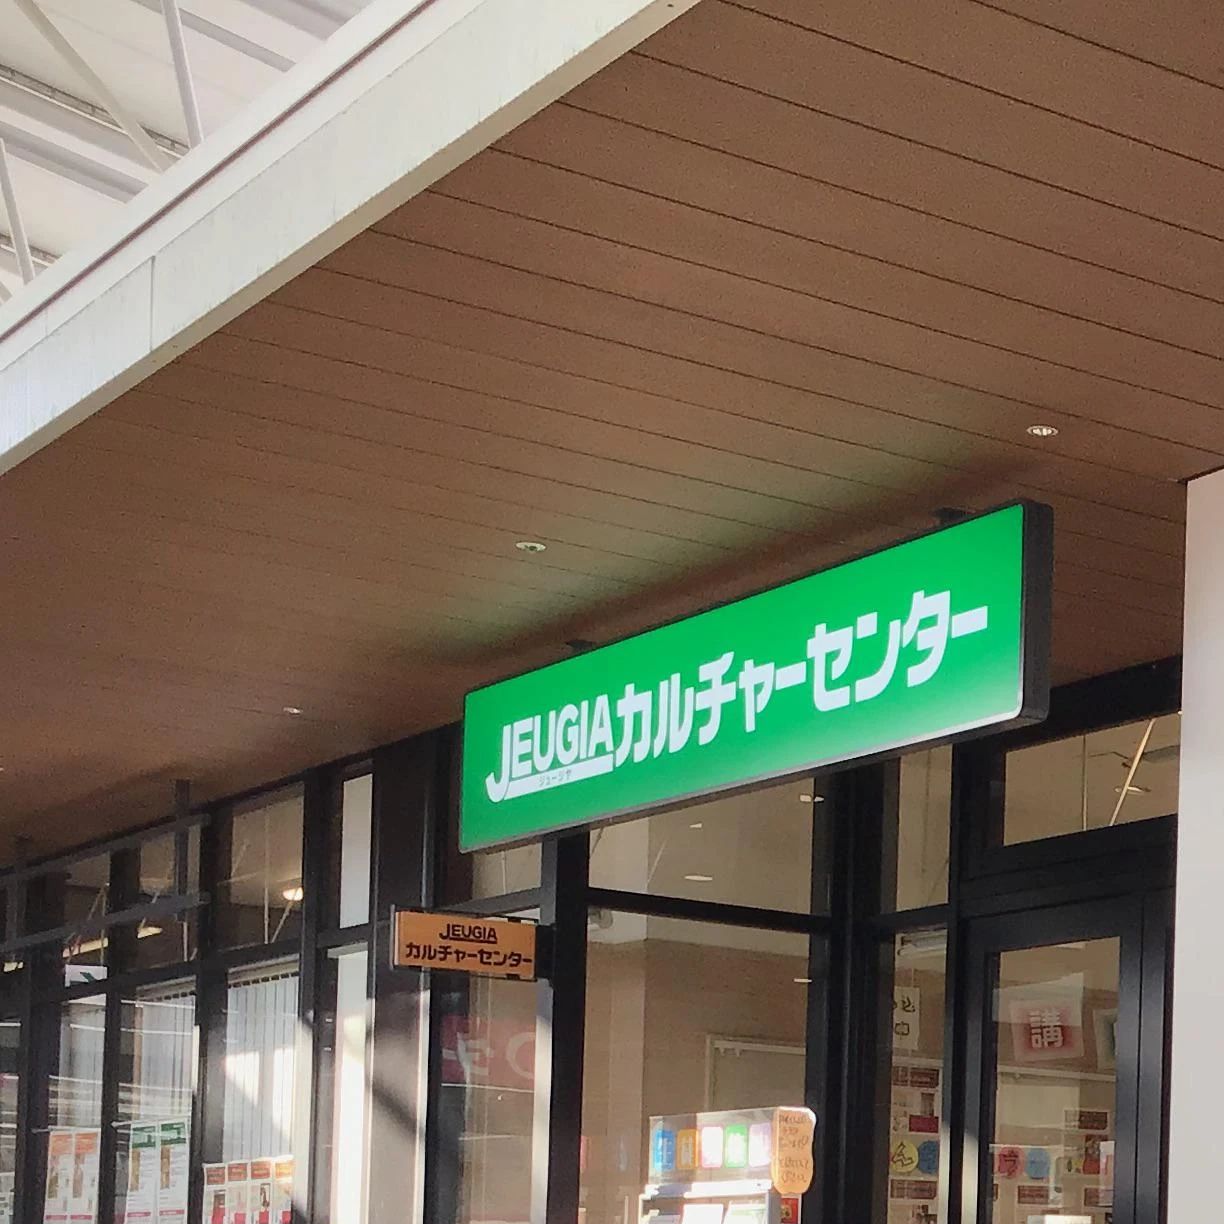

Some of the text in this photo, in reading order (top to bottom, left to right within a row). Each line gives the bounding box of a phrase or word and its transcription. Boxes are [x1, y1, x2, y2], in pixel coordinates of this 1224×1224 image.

[485, 589, 989, 803] JEUGIA カルチャーセンター
[438, 923, 498, 945] JEUGIA
[405, 942, 533, 968] カルチャーセンター
